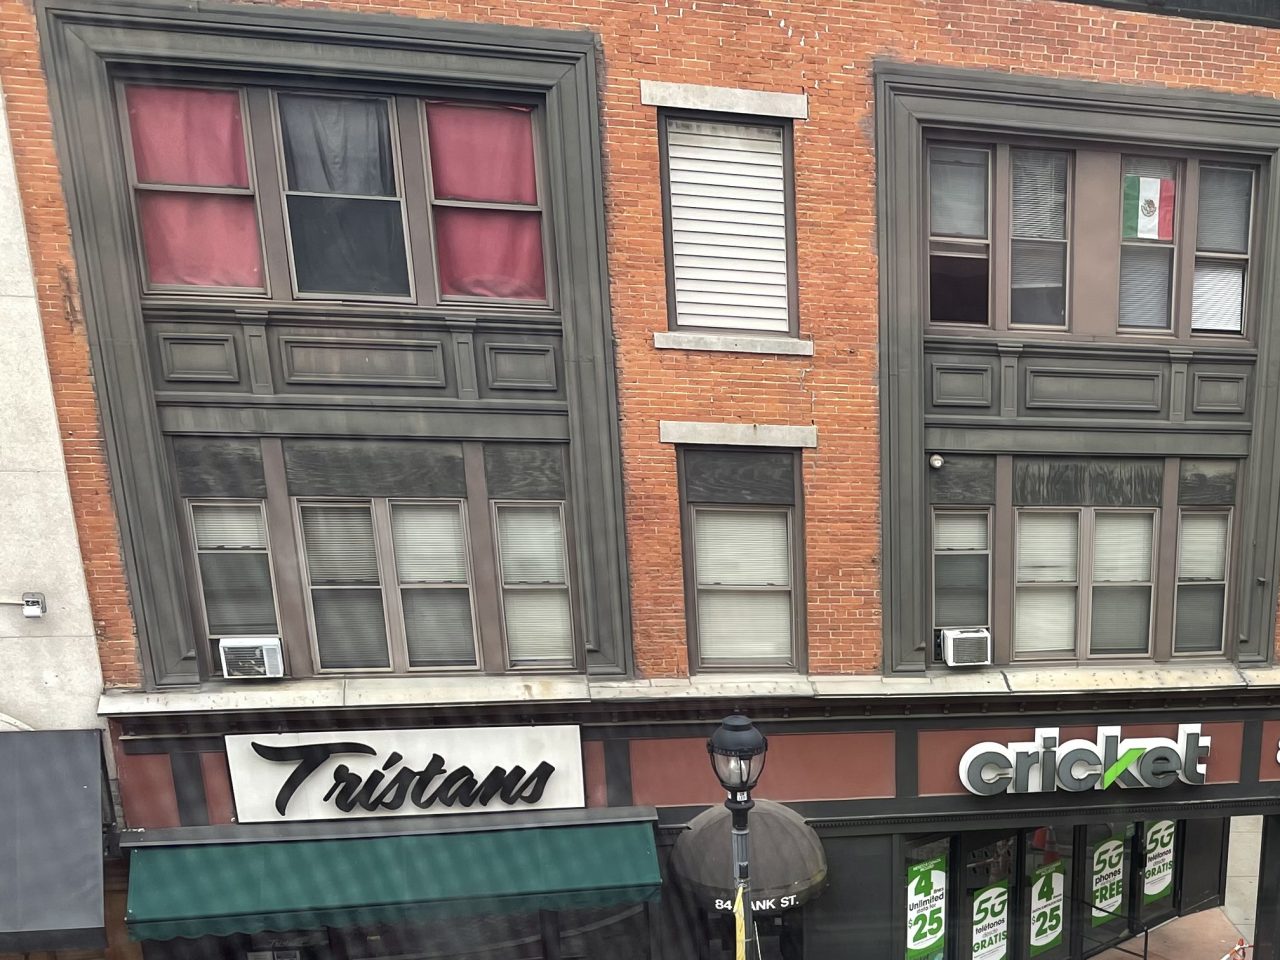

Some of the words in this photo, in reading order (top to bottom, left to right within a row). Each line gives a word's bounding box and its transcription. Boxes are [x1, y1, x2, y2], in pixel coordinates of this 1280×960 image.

[960, 726, 1211, 796] cricket
[251, 741, 556, 816] Tristans
[1146, 823, 1174, 854] 5G
[1093, 843, 1123, 875] 5G
[1145, 861, 1174, 879] GRATIS
[914, 870, 933, 897] 4
[1037, 872, 1054, 902] 4
[1095, 868, 1122, 886] phones
[715, 899, 732, 911] 84
[780, 895, 800, 908] ST.
[909, 892, 944, 911] Unlimited
[1093, 880, 1122, 904] FREE
[973, 890, 1008, 926] 5G
[1032, 904, 1061, 939] $25
[908, 907, 943, 943] $25
[975, 918, 1006, 935] teléfonos
[973, 930, 1008, 953] GRATIS
